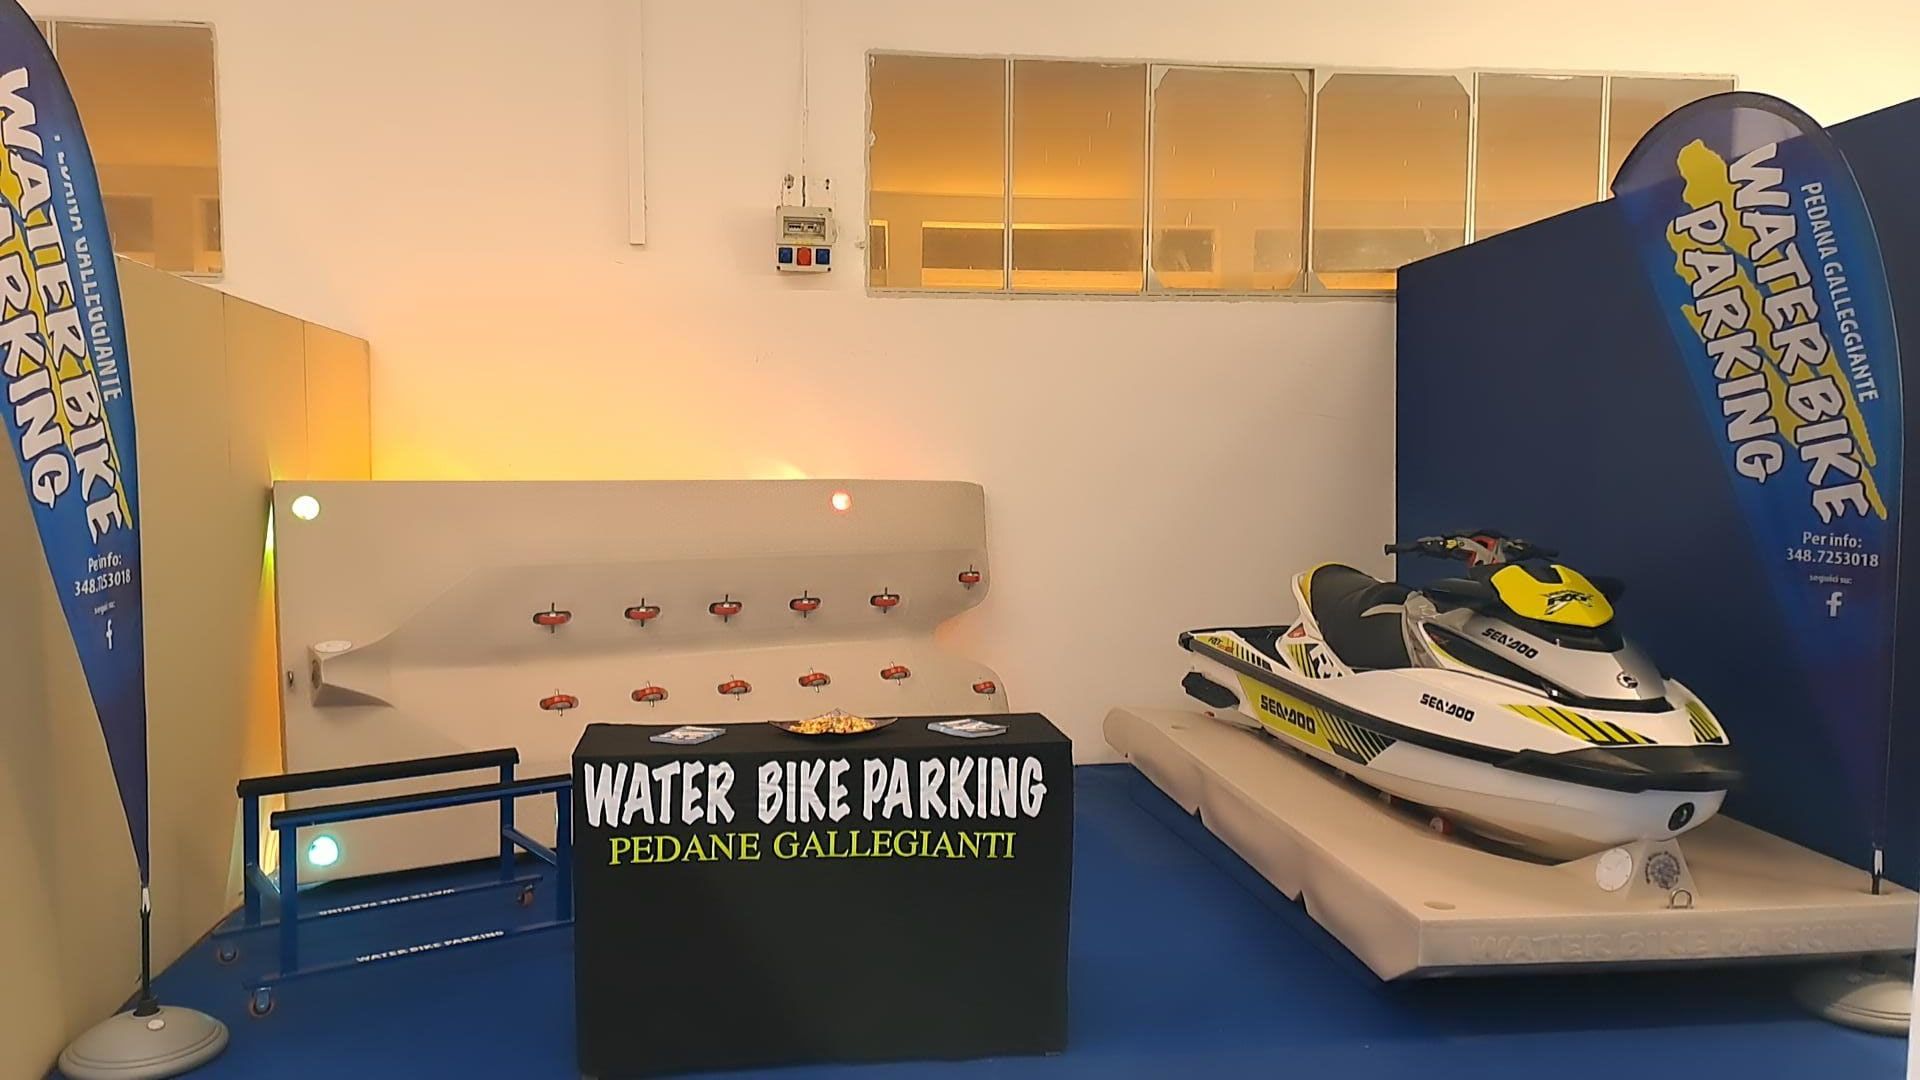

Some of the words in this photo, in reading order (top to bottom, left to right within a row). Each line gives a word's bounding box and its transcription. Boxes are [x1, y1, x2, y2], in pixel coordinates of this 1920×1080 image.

[0, 66, 86, 372] WATER
[60, 372, 123, 545] BIKE
[1801, 181, 1832, 261] PEDANA
[1823, 262, 1880, 403] GALLEGGIANTE
[1673, 202, 1784, 484] PARKING
[1729, 142, 1829, 375] WATER
[1788, 376, 1871, 525] BIKE
[1786, 548, 1880, 568] 348.7253018
[1802, 531, 1828, 546] Per
[1829, 532, 1863, 549] info:
[583, 759, 736, 829] WATER
[757, 757, 851, 824] BIKE
[862, 755, 1048, 822] PARKING
[608, 832, 761, 866] PEDANE
[772, 829, 1017, 859] GALLEGIANTI
[355, 947, 408, 963] WATER
[409, 942, 442, 953] BIKE
[444, 930, 505, 946] PARKING
[1470, 933, 1613, 962] WATER
